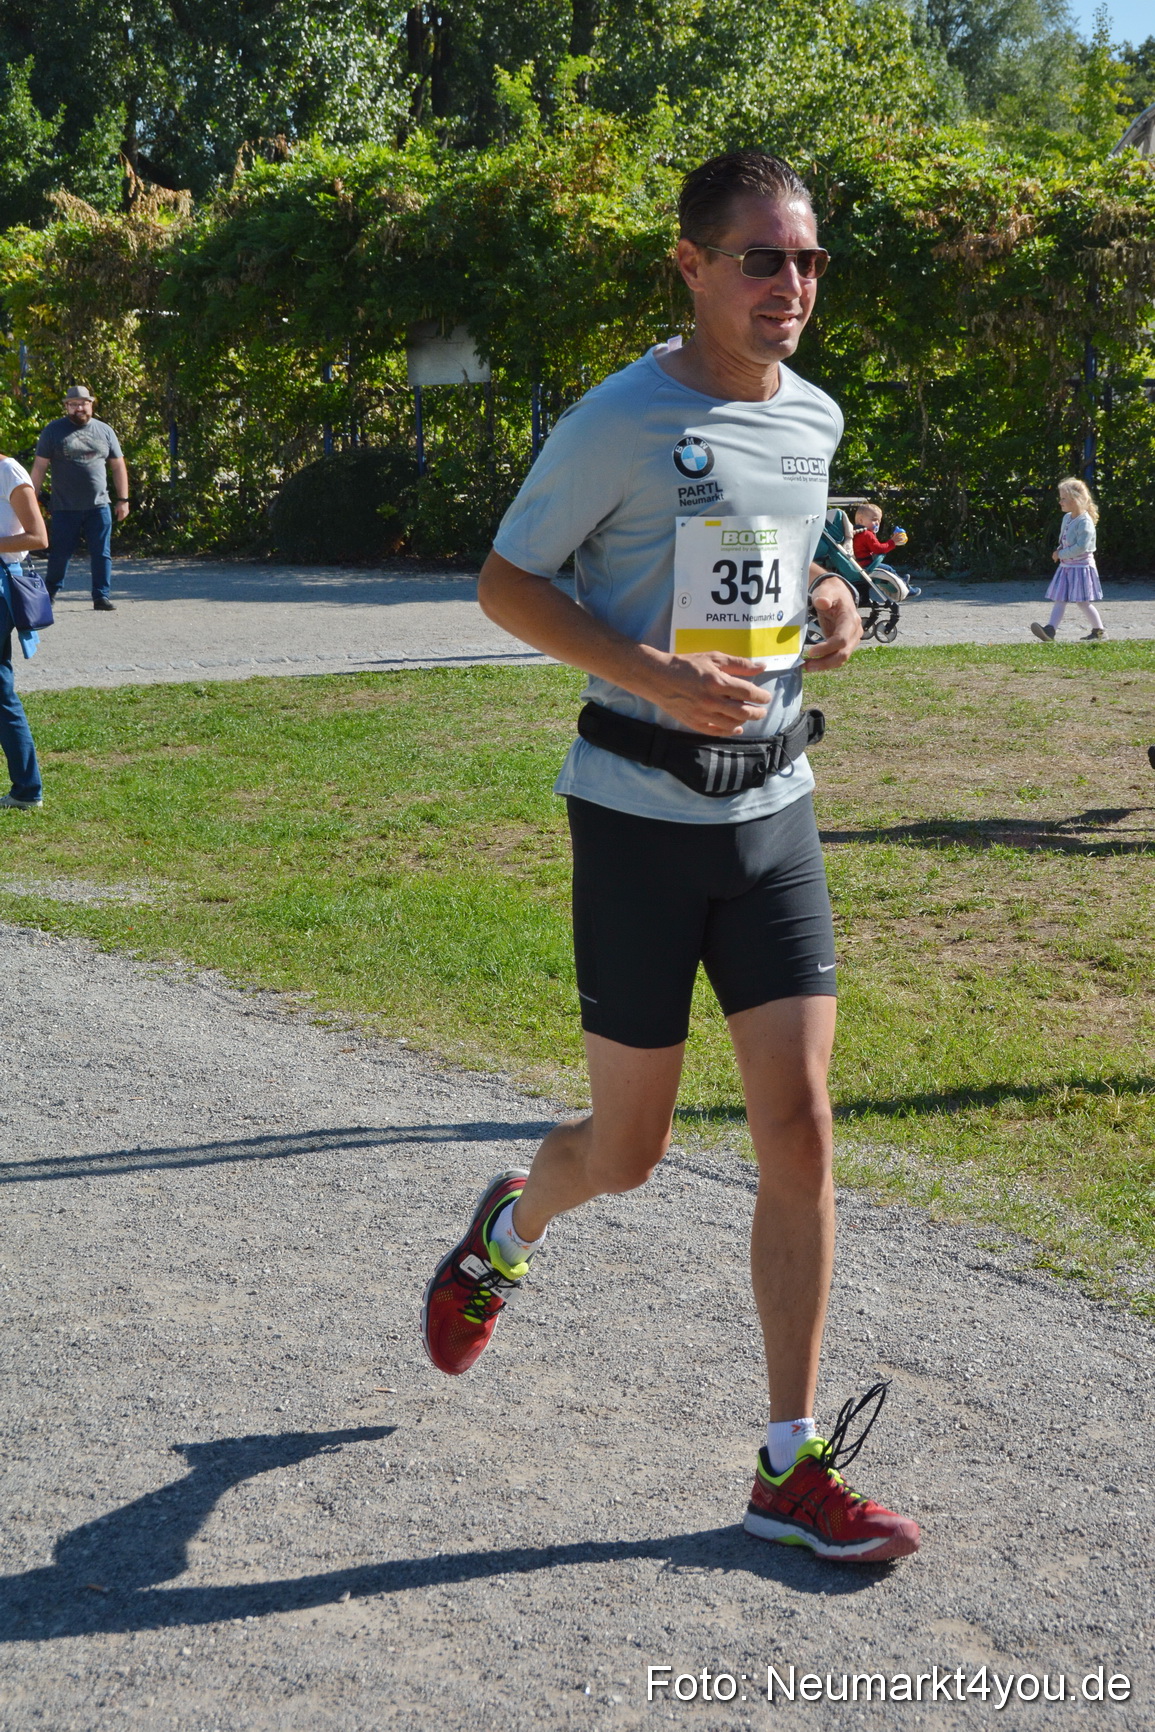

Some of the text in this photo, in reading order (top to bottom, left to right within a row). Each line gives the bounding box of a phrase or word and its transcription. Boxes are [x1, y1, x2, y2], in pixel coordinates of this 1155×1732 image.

[675, 437, 708, 453] BMW
[781, 456, 827, 476] BOCK
[678, 481, 723, 498] PARTL
[680, 493, 724, 507] Neumarkt
[721, 529, 778, 546] BOCK
[711, 558, 781, 605] 354
[706, 612, 775, 622] PARTL Neumarkt
